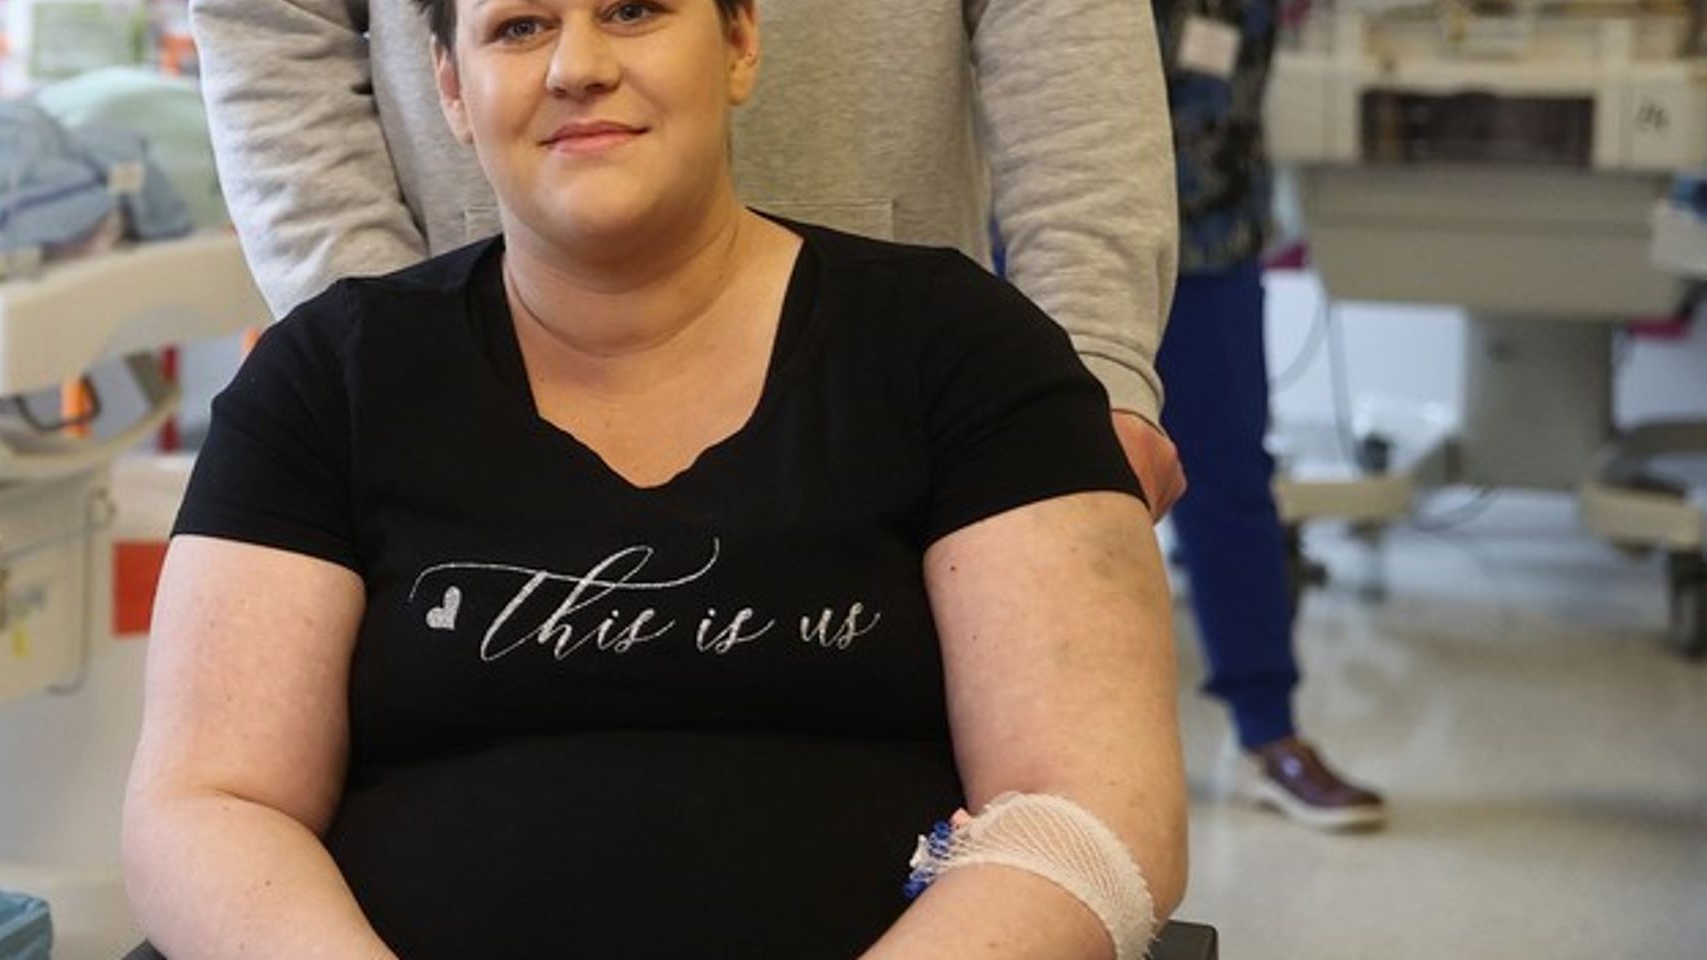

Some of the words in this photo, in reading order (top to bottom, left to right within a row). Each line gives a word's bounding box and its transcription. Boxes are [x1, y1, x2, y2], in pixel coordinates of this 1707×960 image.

[409, 537, 720, 662] This
[695, 606, 775, 656] is
[799, 601, 881, 651] us
